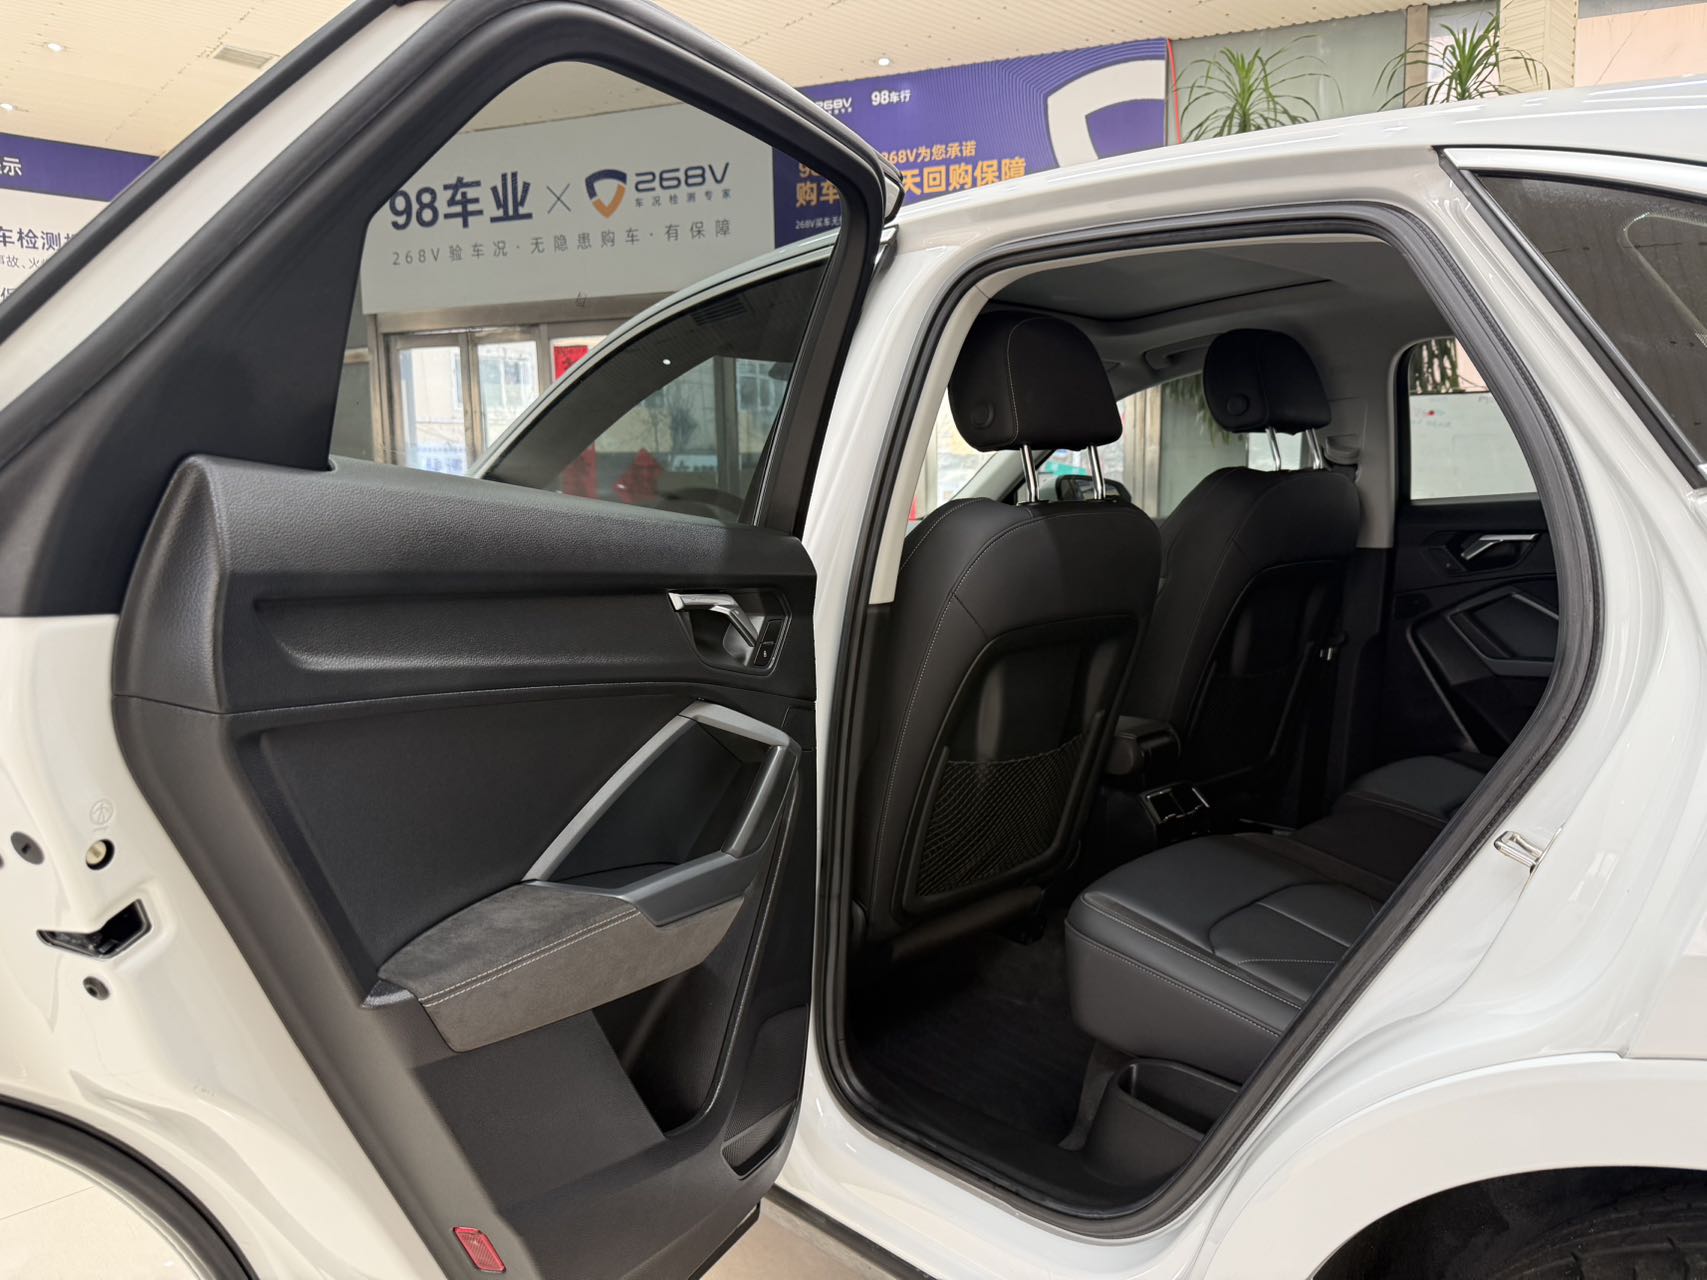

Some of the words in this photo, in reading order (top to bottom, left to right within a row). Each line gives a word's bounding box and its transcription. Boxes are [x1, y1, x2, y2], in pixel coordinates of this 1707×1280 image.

[0, 156, 22, 176] 示
[634, 162, 730, 193] 268V
[388, 171, 533, 231] 98车业
